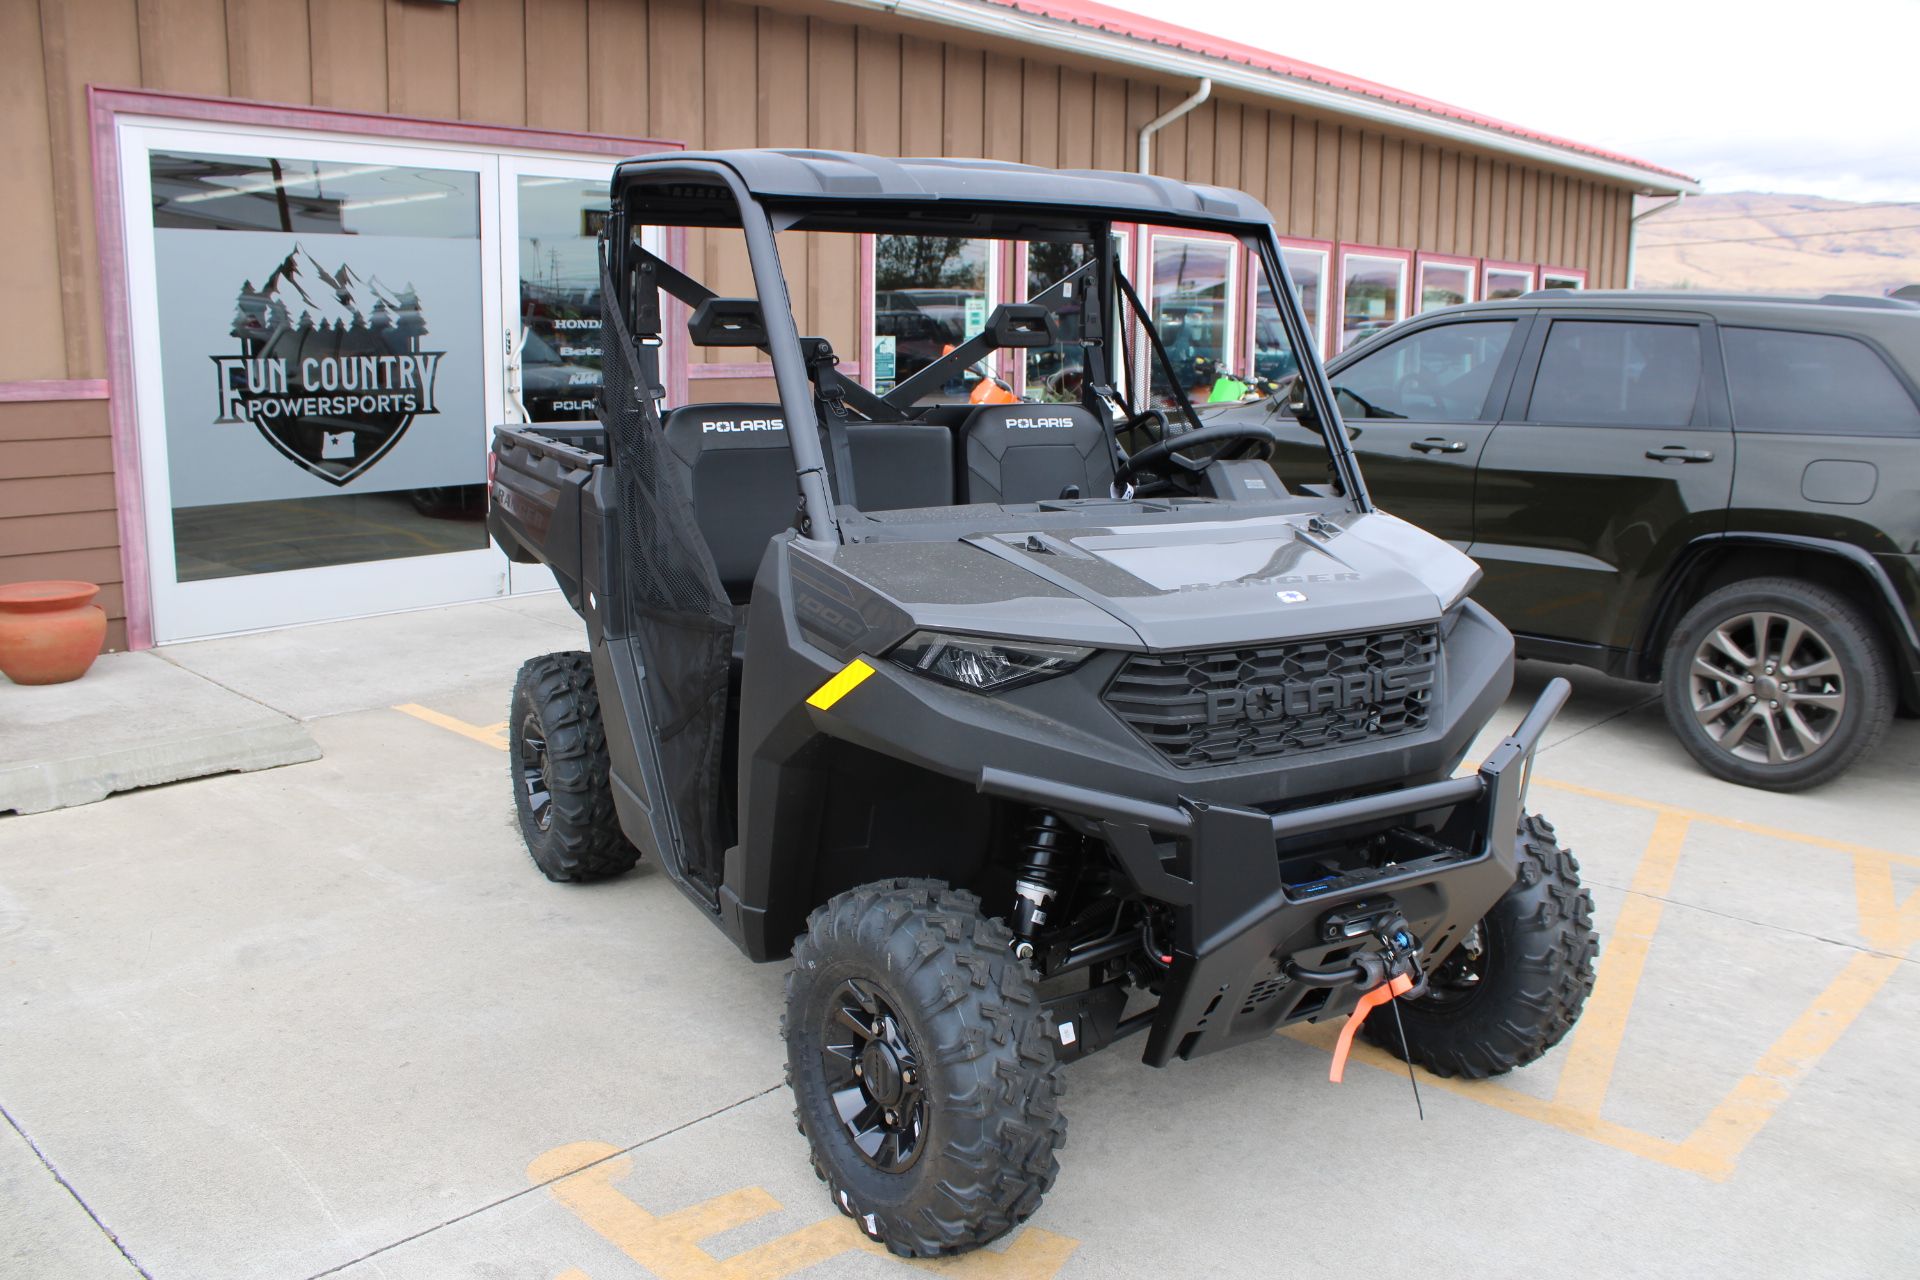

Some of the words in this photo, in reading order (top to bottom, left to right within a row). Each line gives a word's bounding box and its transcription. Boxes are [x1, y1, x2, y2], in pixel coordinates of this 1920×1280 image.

[219, 358, 288, 420] FUN
[302, 355, 437, 411] COUNTRY
[250, 394, 417, 418] POWERSPORTS
[702, 419, 784, 433] POLARIS
[1005, 418, 1074, 429] POLARIS
[1180, 573, 1361, 593] RANGER
[1206, 666, 1411, 725] POLARIS
